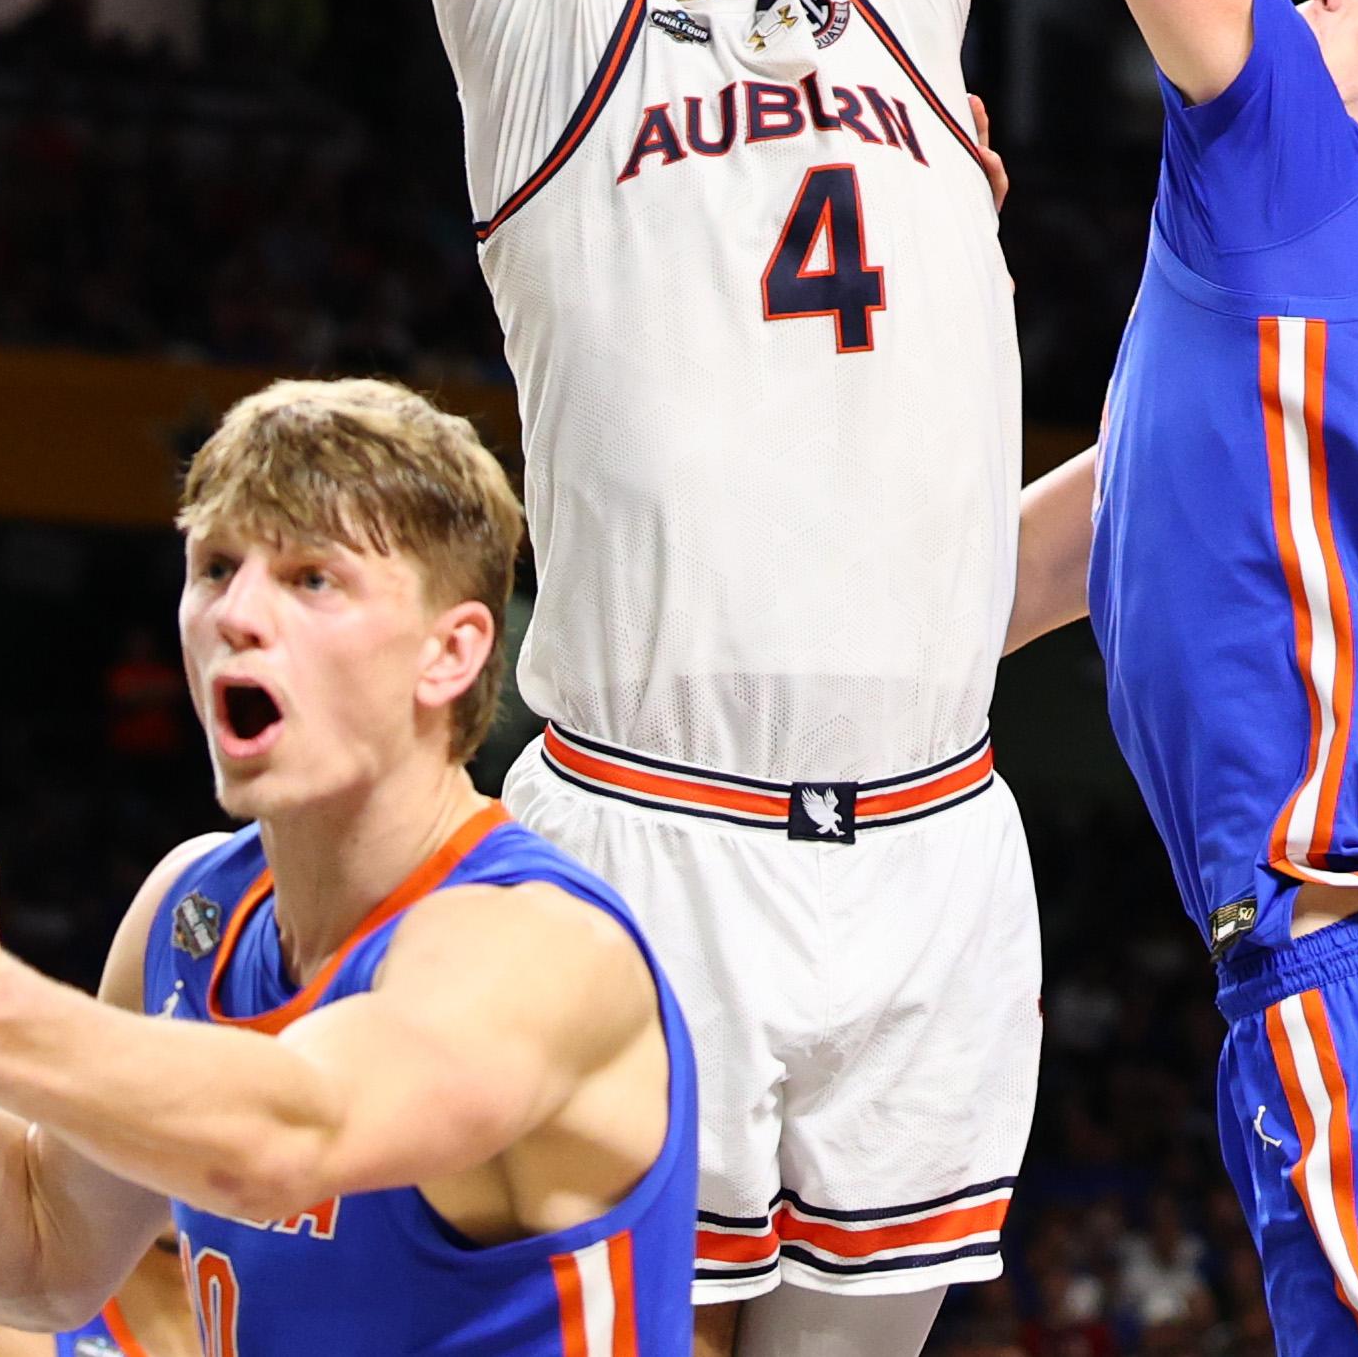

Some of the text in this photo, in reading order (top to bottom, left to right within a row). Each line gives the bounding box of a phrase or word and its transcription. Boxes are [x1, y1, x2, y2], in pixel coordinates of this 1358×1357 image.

[653, 13, 709, 40] FINAL FOUR
[761, 162, 886, 354] 4
